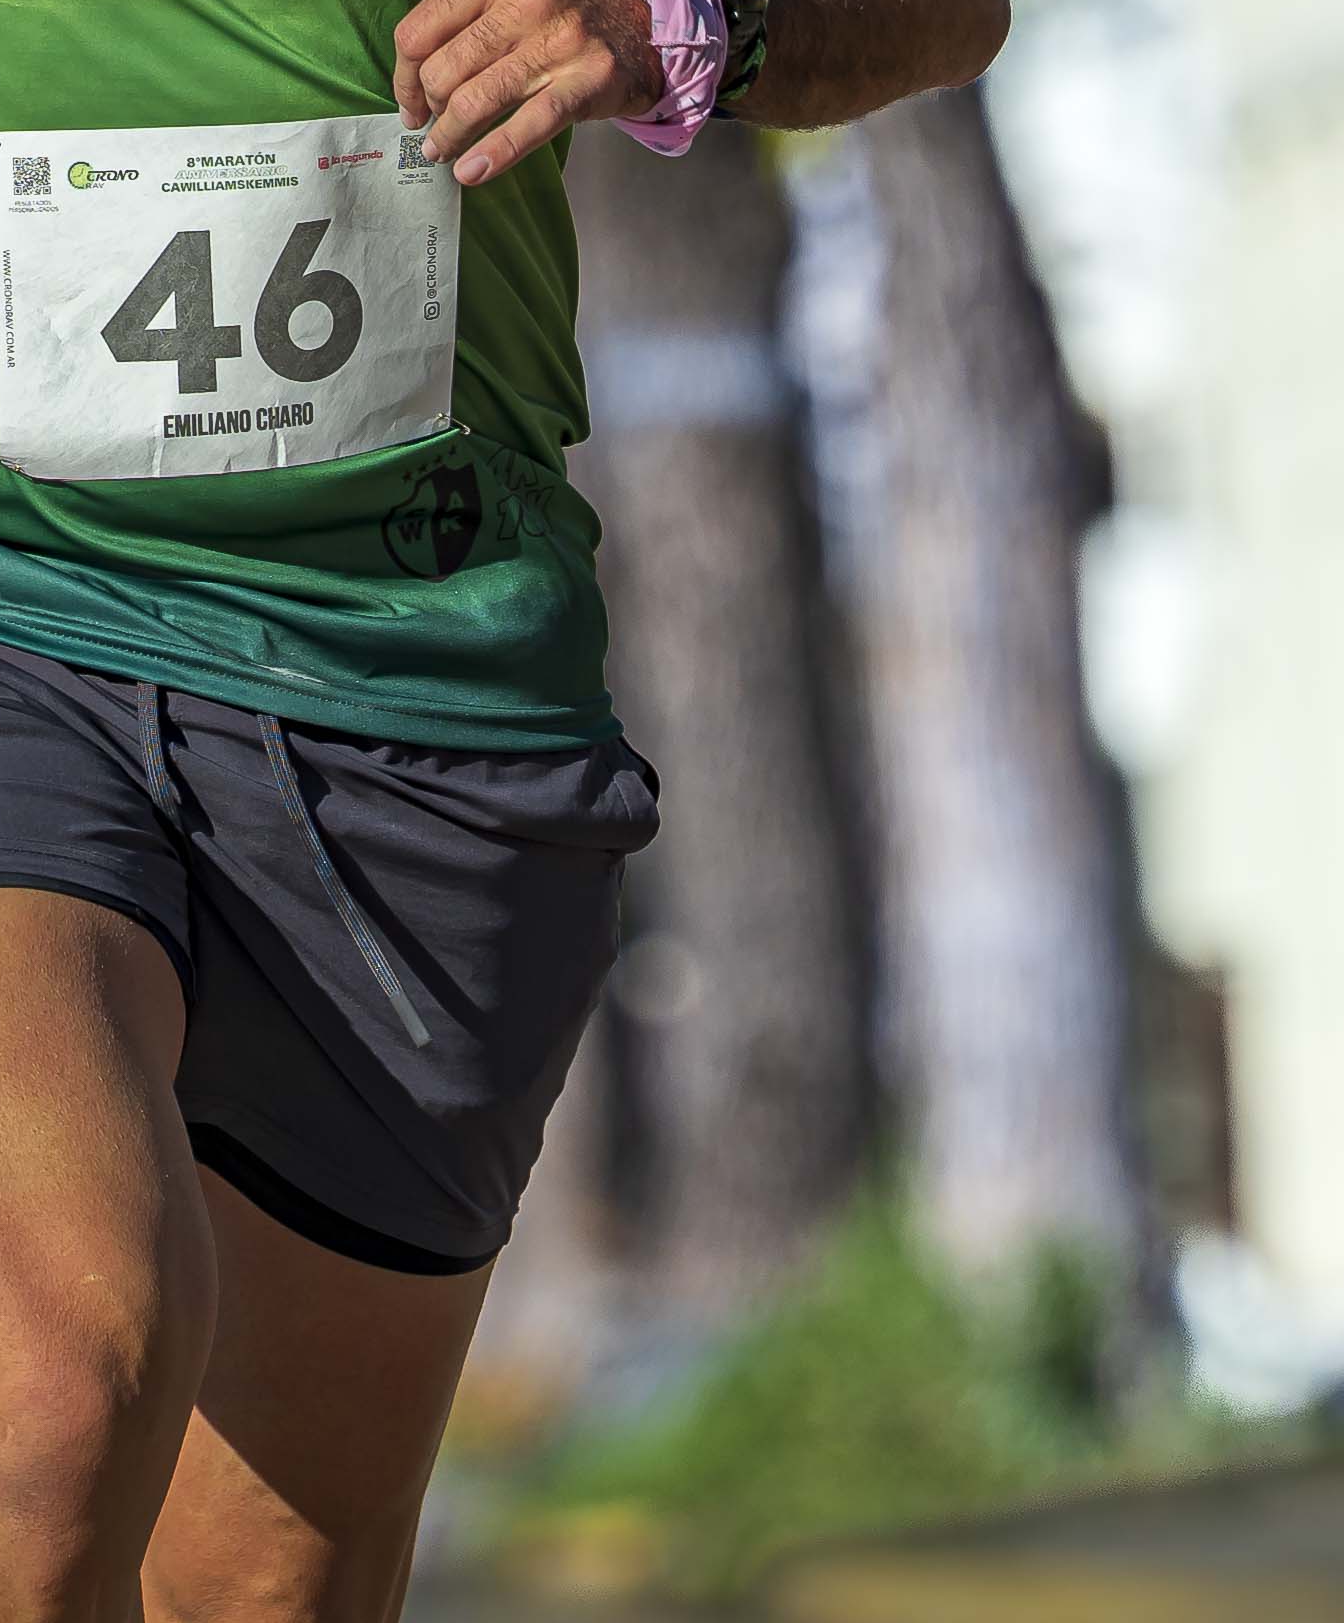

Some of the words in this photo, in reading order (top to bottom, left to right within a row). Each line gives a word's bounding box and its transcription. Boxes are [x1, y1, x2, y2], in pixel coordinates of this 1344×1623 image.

[161, 176, 299, 193] CAWILLIAMSKEMMIS
[426, 224, 439, 300] @CRONORAV
[100, 218, 364, 395] 46
[163, 409, 252, 439] EMILIANO
[256, 401, 315, 431] CHARO
